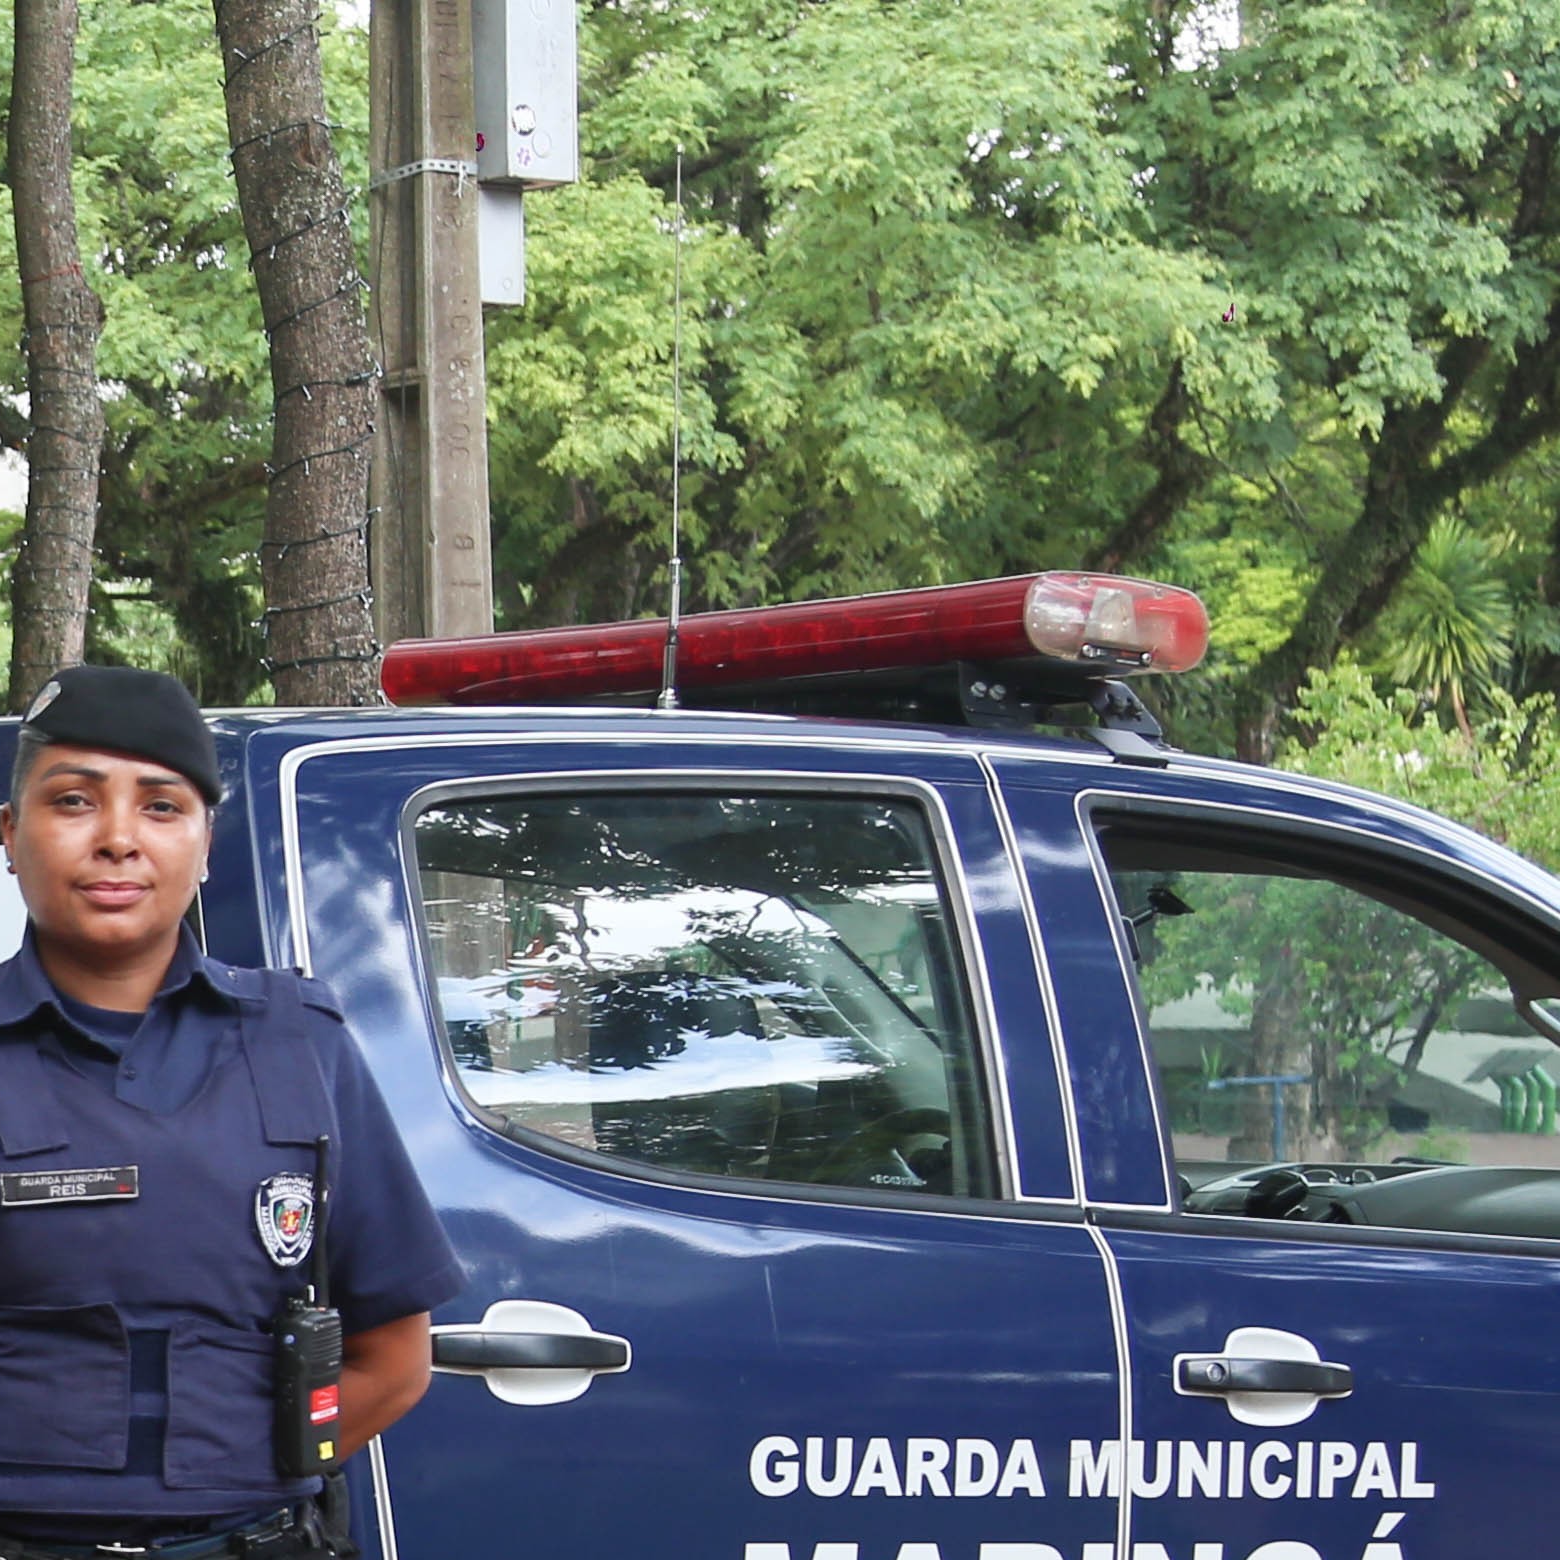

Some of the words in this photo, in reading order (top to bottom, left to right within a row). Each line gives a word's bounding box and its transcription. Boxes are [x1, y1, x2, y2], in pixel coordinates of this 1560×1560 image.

[20, 1174, 62, 1187] GUARDA
[63, 1172, 116, 1184] MUNICIPAL
[49, 1183, 87, 1197] REIS
[749, 1436, 1045, 1498] GUARDA
[1068, 1439, 1435, 1500] MUNICIPAL
